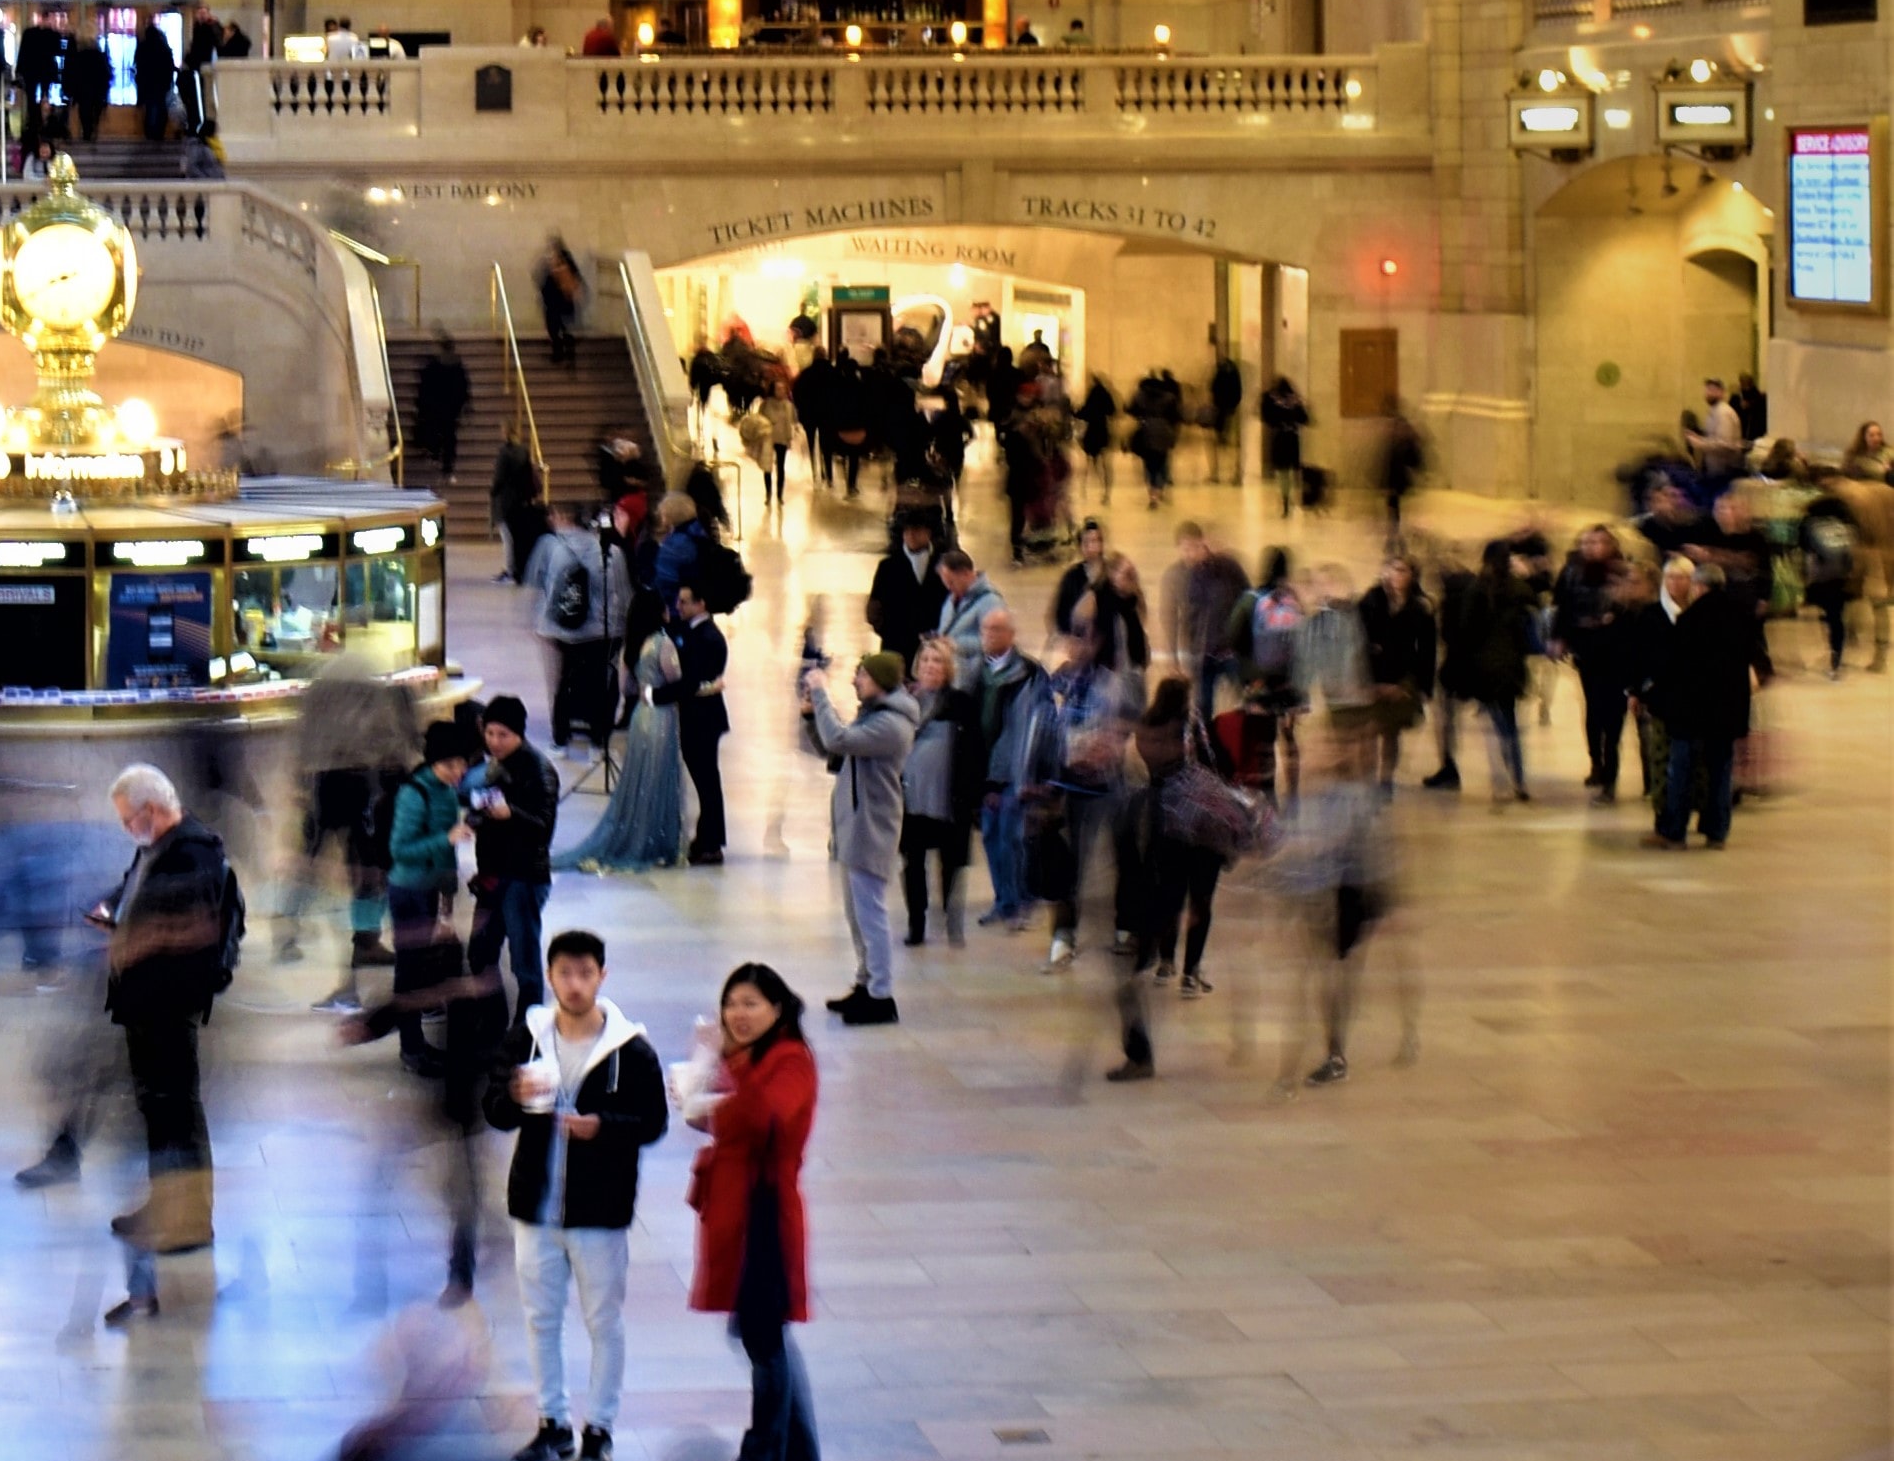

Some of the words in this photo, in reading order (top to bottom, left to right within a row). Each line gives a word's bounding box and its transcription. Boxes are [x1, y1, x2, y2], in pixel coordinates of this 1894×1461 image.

[450, 182, 538, 199] BALCONY
[708, 210, 795, 245] TICKET
[805, 196, 934, 226] MACHINES
[1023, 196, 1118, 222] TRACKS
[1129, 206, 1146, 226] 31
[1154, 208, 1187, 232] TO
[1193, 217, 1217, 239] 42
[852, 236, 945, 258] WAITING
[955, 244, 1016, 269] ROOM
[25, 451, 145, 480] Information
